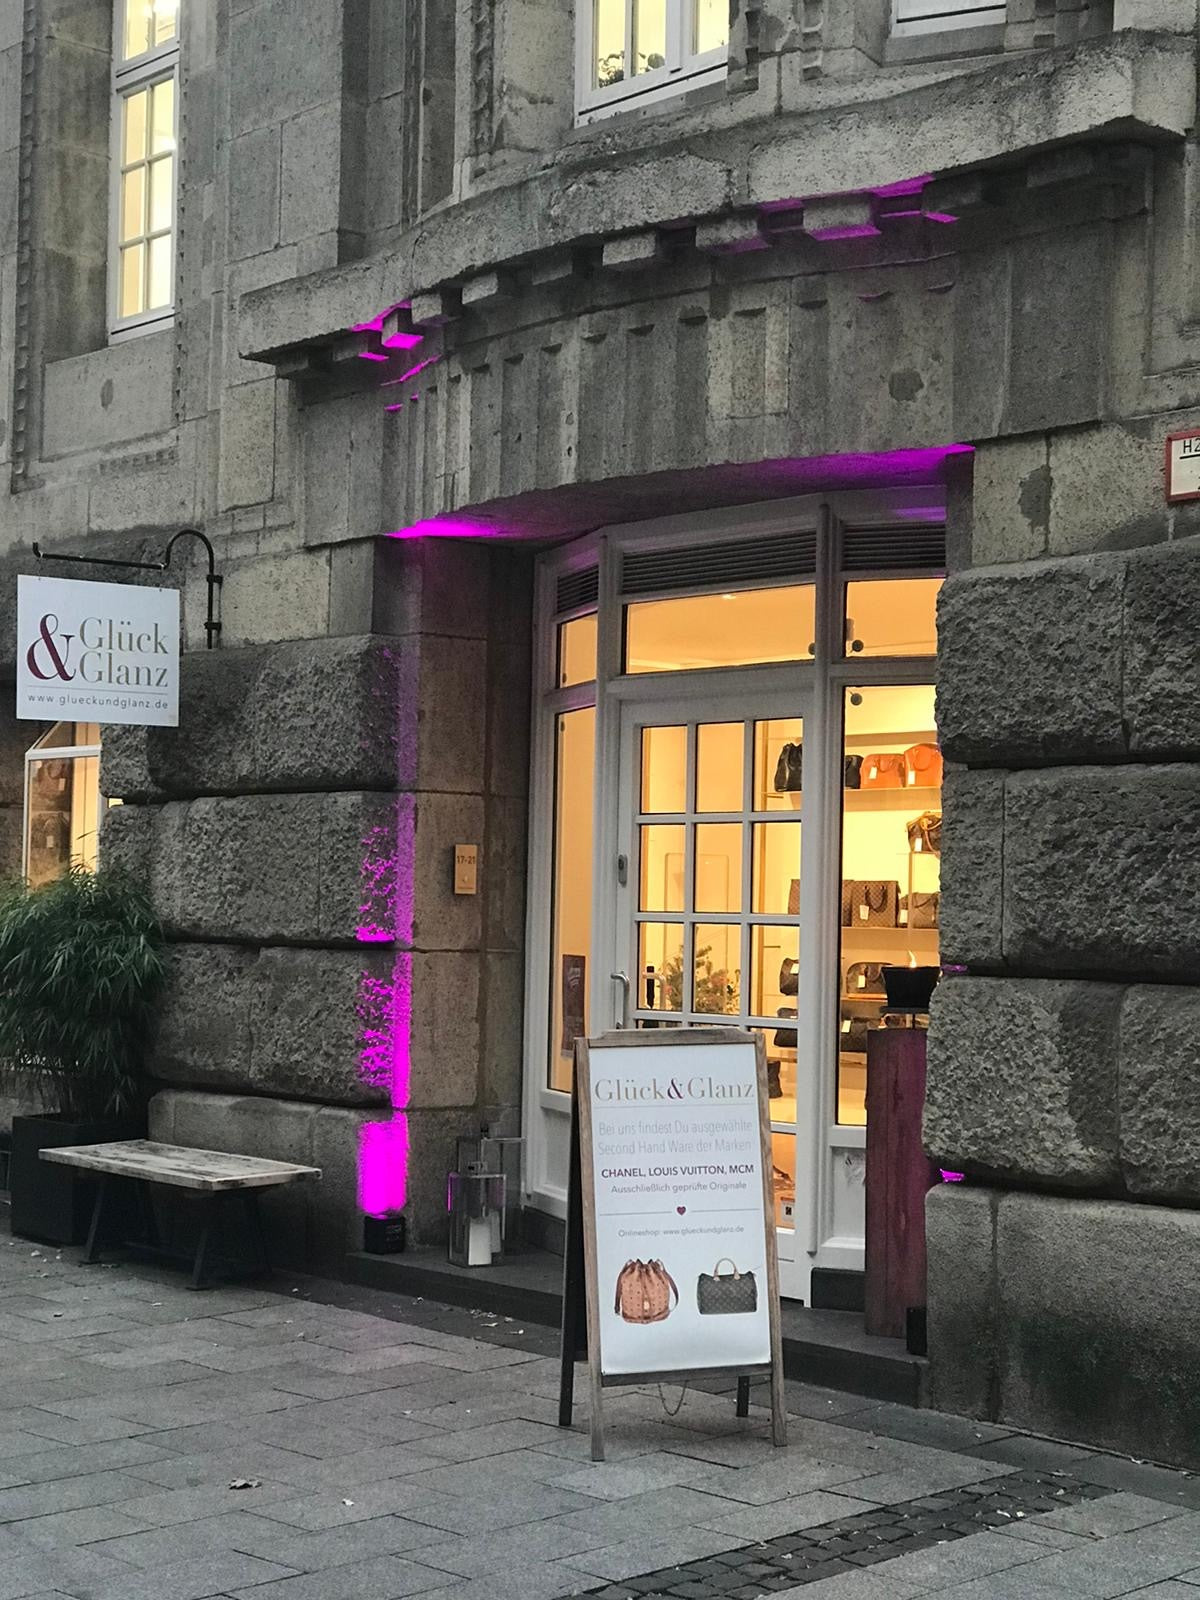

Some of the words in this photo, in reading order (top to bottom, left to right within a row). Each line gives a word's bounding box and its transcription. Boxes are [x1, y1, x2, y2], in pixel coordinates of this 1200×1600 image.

[79, 616, 169, 654] Glück
[26, 613, 77, 681] &
[79, 650, 169, 687] Glanz
[27, 693, 169, 709] www.glueckundglanz.de
[456, 855, 476, 865] 17-21
[598, 1121, 615, 1136] Bei
[617, 1124, 636, 1135] uns
[638, 1120, 672, 1135] findest
[674, 1120, 689, 1134] Du
[692, 1119, 753, 1137] ausgewählte
[597, 1139, 636, 1156] Second
[638, 1139, 666, 1153] Hand
[668, 1139, 693, 1153] Ware
[696, 1139, 712, 1152] der
[714, 1138, 752, 1152] Marken
[601, 1167, 647, 1179] CHANEL,
[648, 1166, 679, 1177] LOUIS
[681, 1165, 728, 1176] VUITTON,
[729, 1164, 755, 1174] MCM
[610, 1182, 671, 1194] Ausschließlich
[672, 1181, 708, 1194] geprüfte
[709, 1180, 748, 1192] Originale
